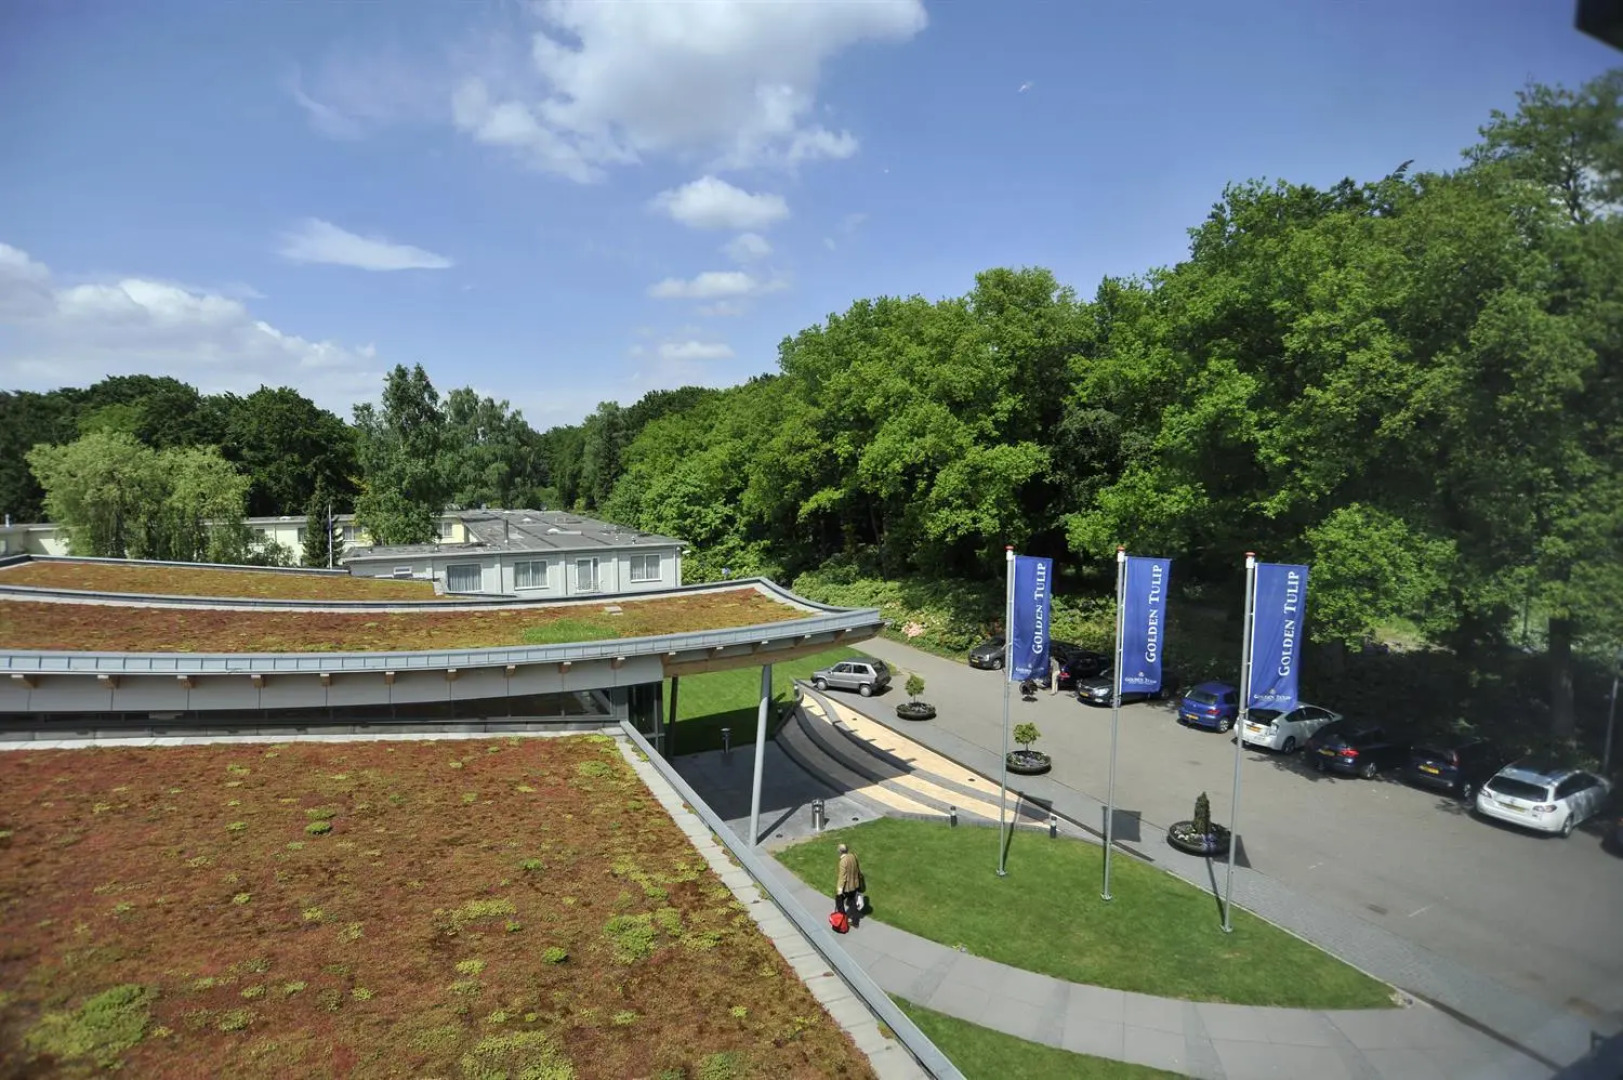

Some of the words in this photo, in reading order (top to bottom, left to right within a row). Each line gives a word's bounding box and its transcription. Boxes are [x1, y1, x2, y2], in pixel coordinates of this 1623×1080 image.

[1034, 562, 1046, 600] TULIP
[1149, 564, 1163, 604] TULIP
[1283, 571, 1300, 614] TULIP
[1032, 604, 1043, 654] GOLDEN
[1145, 609, 1159, 663] GOLDEN
[1278, 619, 1295, 677] GOLDEN
